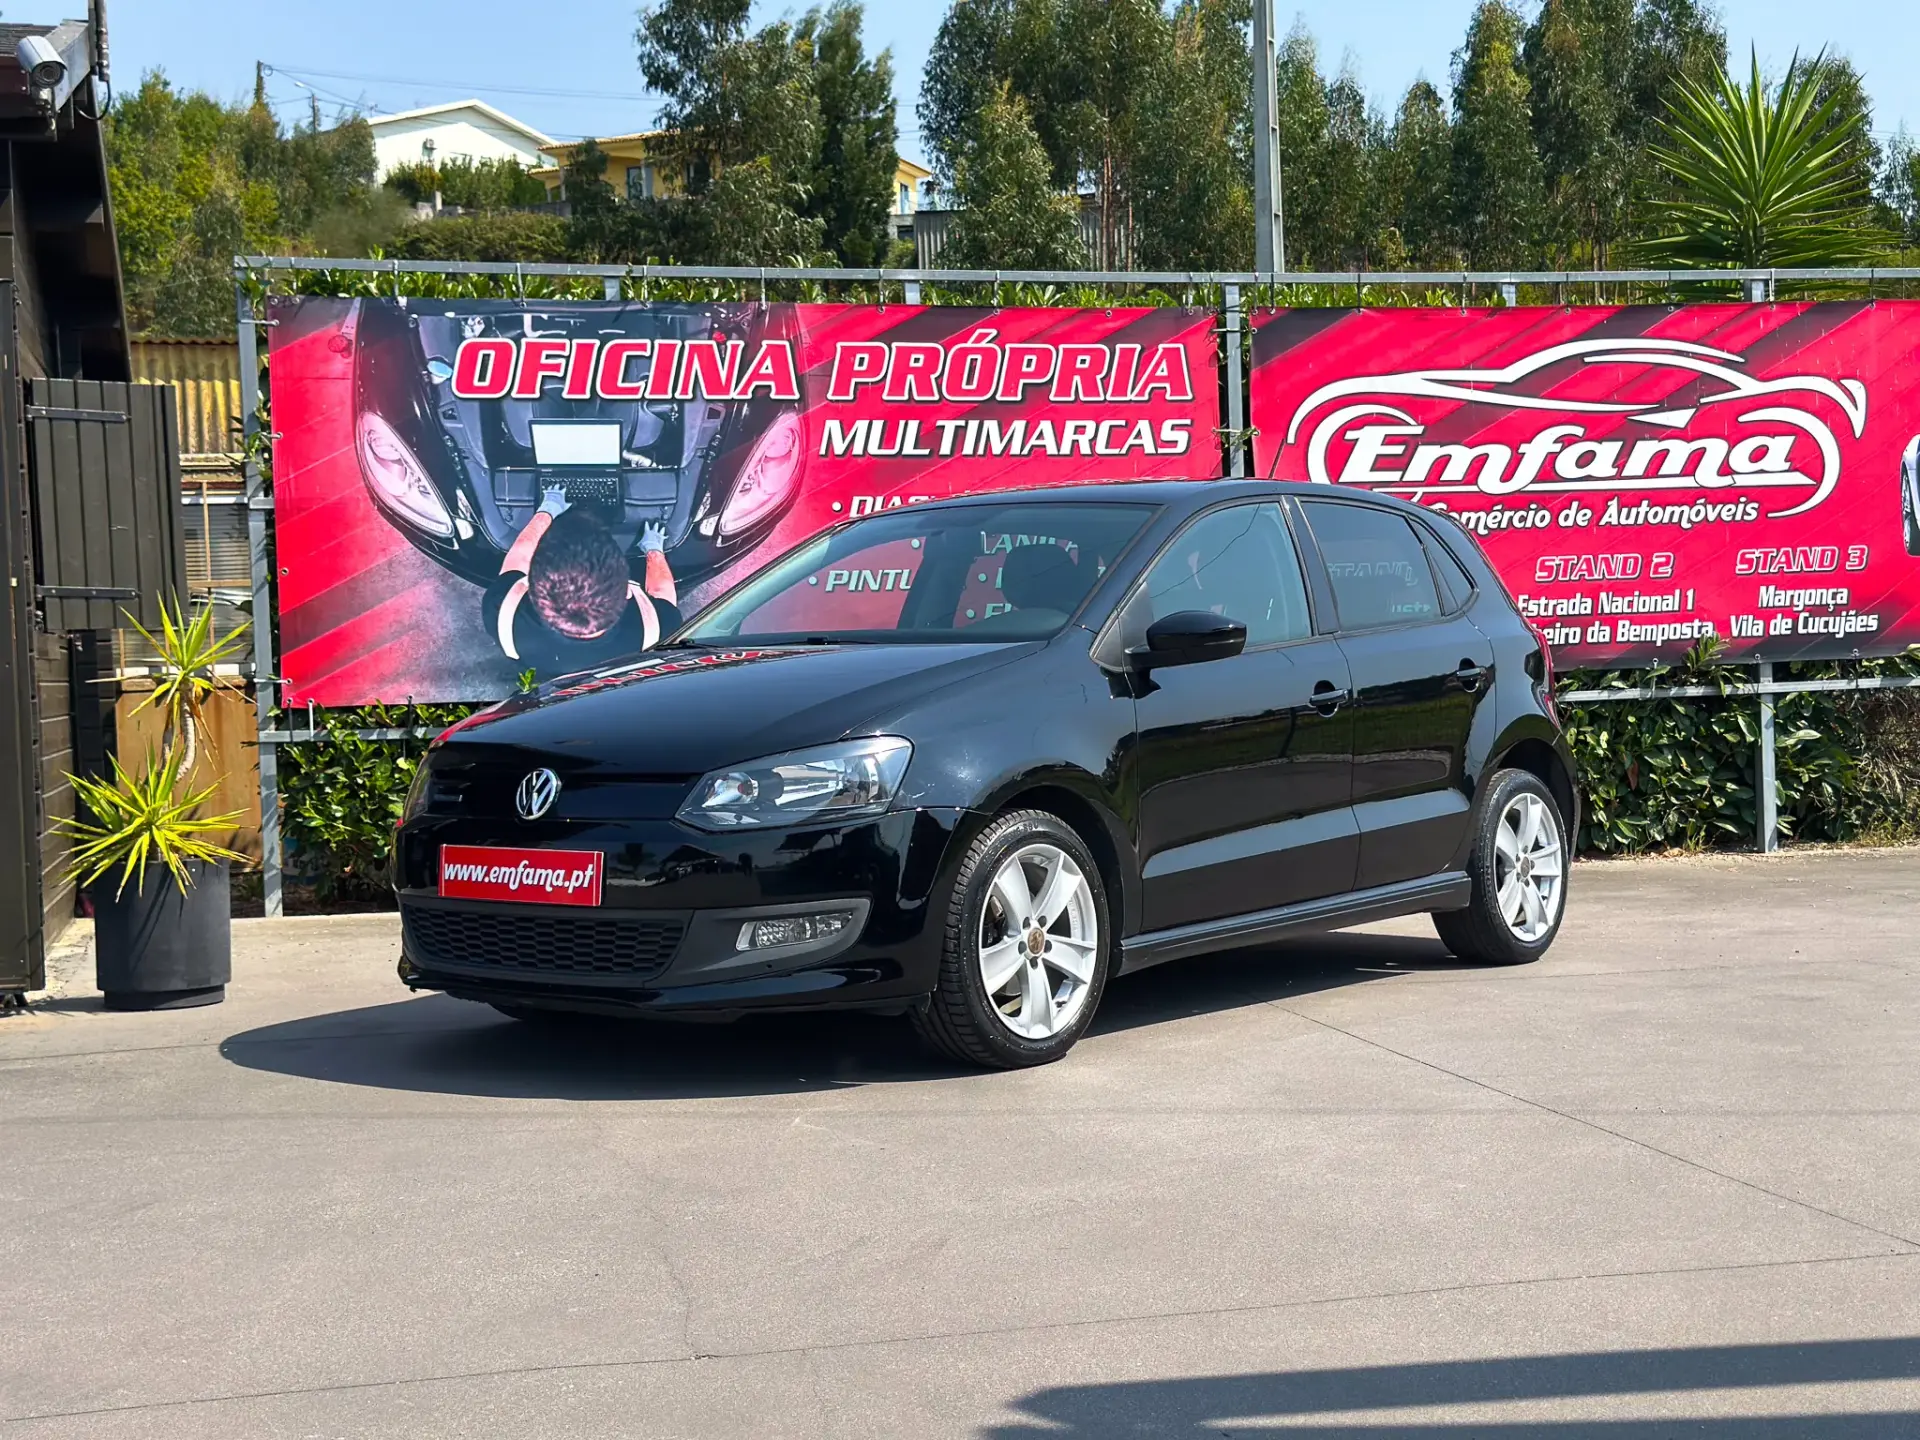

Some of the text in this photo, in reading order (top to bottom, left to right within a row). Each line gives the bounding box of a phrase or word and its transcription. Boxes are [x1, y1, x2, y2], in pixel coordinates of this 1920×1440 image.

[451, 328, 1193, 401] OFICINA PRÓPRIA
[819, 418, 1192, 456] MULTIMARCAS
[1338, 424, 1798, 495] Emfama
[849, 495, 937, 518] DIA
[1558, 500, 1592, 528] de
[1601, 496, 1759, 528] Automóveis
[1535, 552, 1674, 581] STAND 2
[1735, 545, 1869, 574] STAND 3
[1518, 588, 1695, 617] Estrada Nacional 1
[1758, 585, 1849, 611] Margonça
[1587, 621, 1611, 643] da
[1616, 618, 1713, 646] Bemposta
[1730, 610, 1879, 638] Vila de Cucujães
[444, 860, 594, 894] www.emfama.pt
